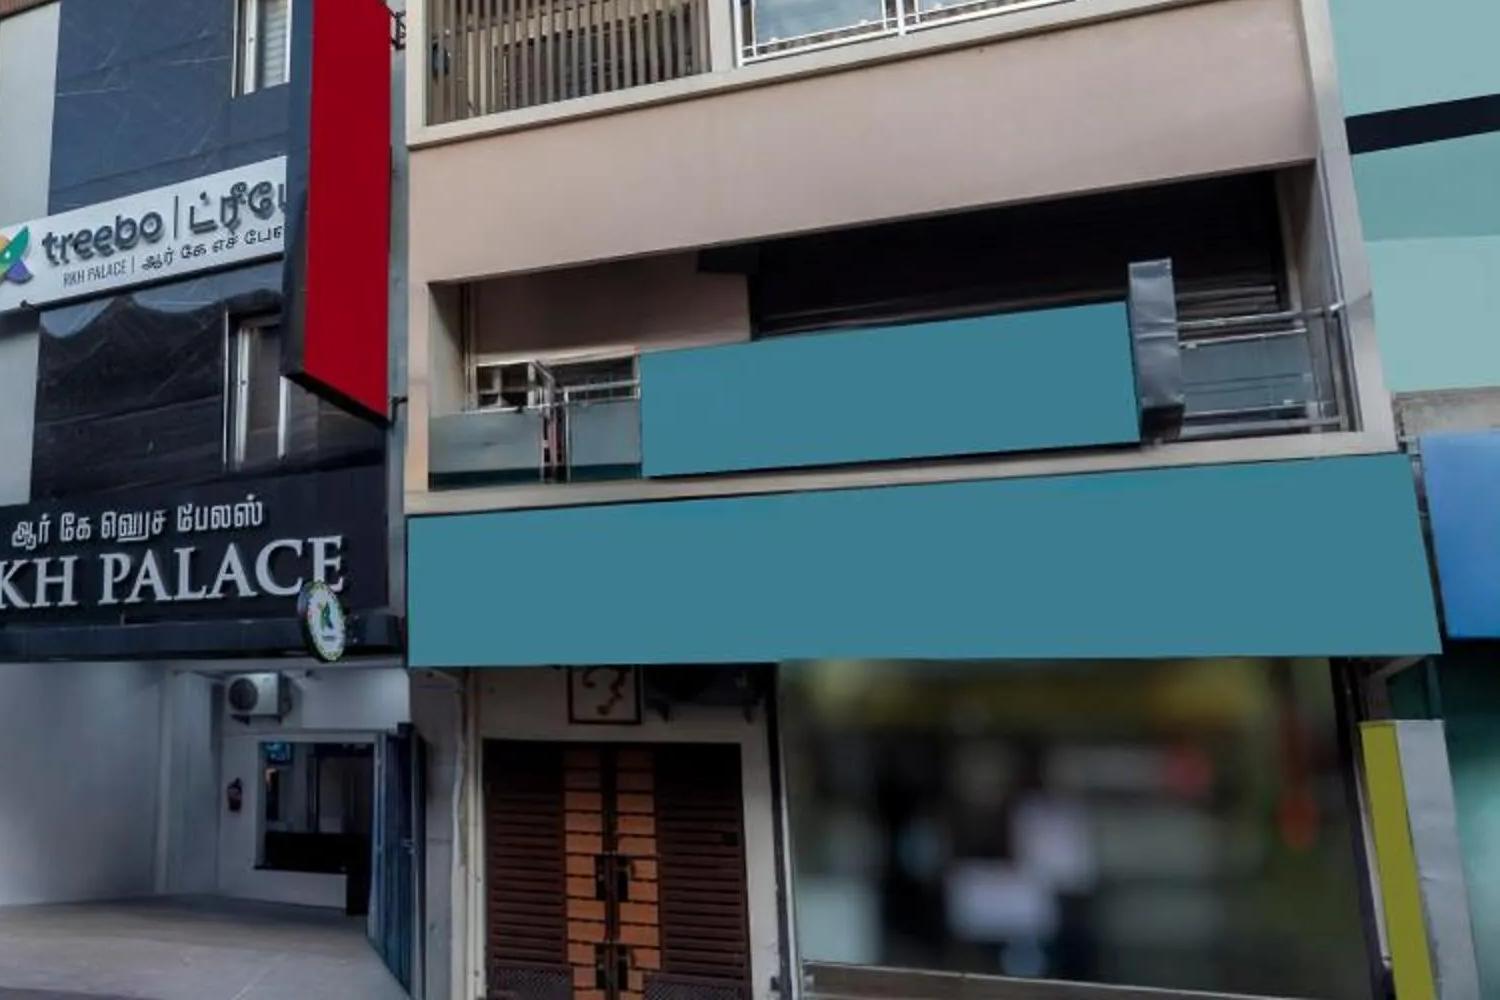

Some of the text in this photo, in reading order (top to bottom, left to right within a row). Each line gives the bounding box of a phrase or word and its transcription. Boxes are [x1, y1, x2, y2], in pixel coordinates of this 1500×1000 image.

[42, 211, 164, 265] treebo
[63, 258, 127, 288] RKH PALACE
[60, 512, 92, 543] கே
[97, 535, 344, 606] PALACE
